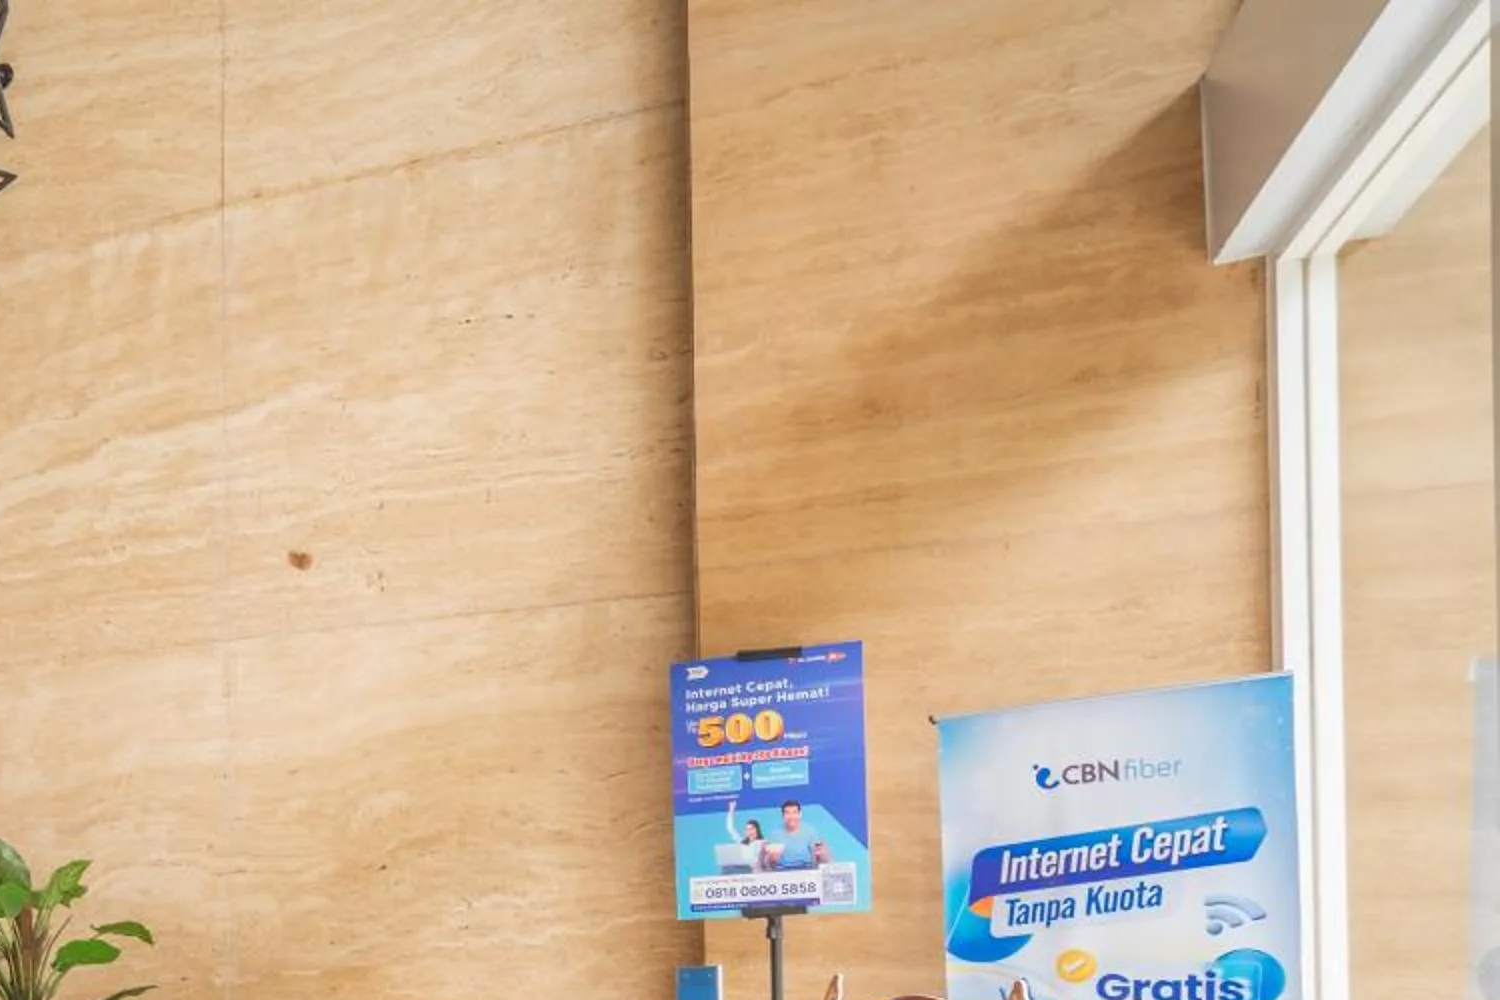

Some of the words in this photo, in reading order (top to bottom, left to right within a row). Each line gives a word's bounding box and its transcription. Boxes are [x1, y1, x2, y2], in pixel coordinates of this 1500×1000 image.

[685, 684, 742, 700] Internet
[685, 699, 727, 715] Harga
[731, 694, 773, 711] Super
[697, 708, 785, 748] 500
[1061, 760, 1120, 784] CBN
[1124, 757, 1183, 781] fiber
[1000, 833, 1121, 885] Internet
[1130, 815, 1228, 864] Cepat
[740, 882, 777, 897] 0800
[781, 881, 817, 895] 5858
[1005, 896, 1076, 928] Tanpa
[1085, 881, 1164, 915] Kuota
